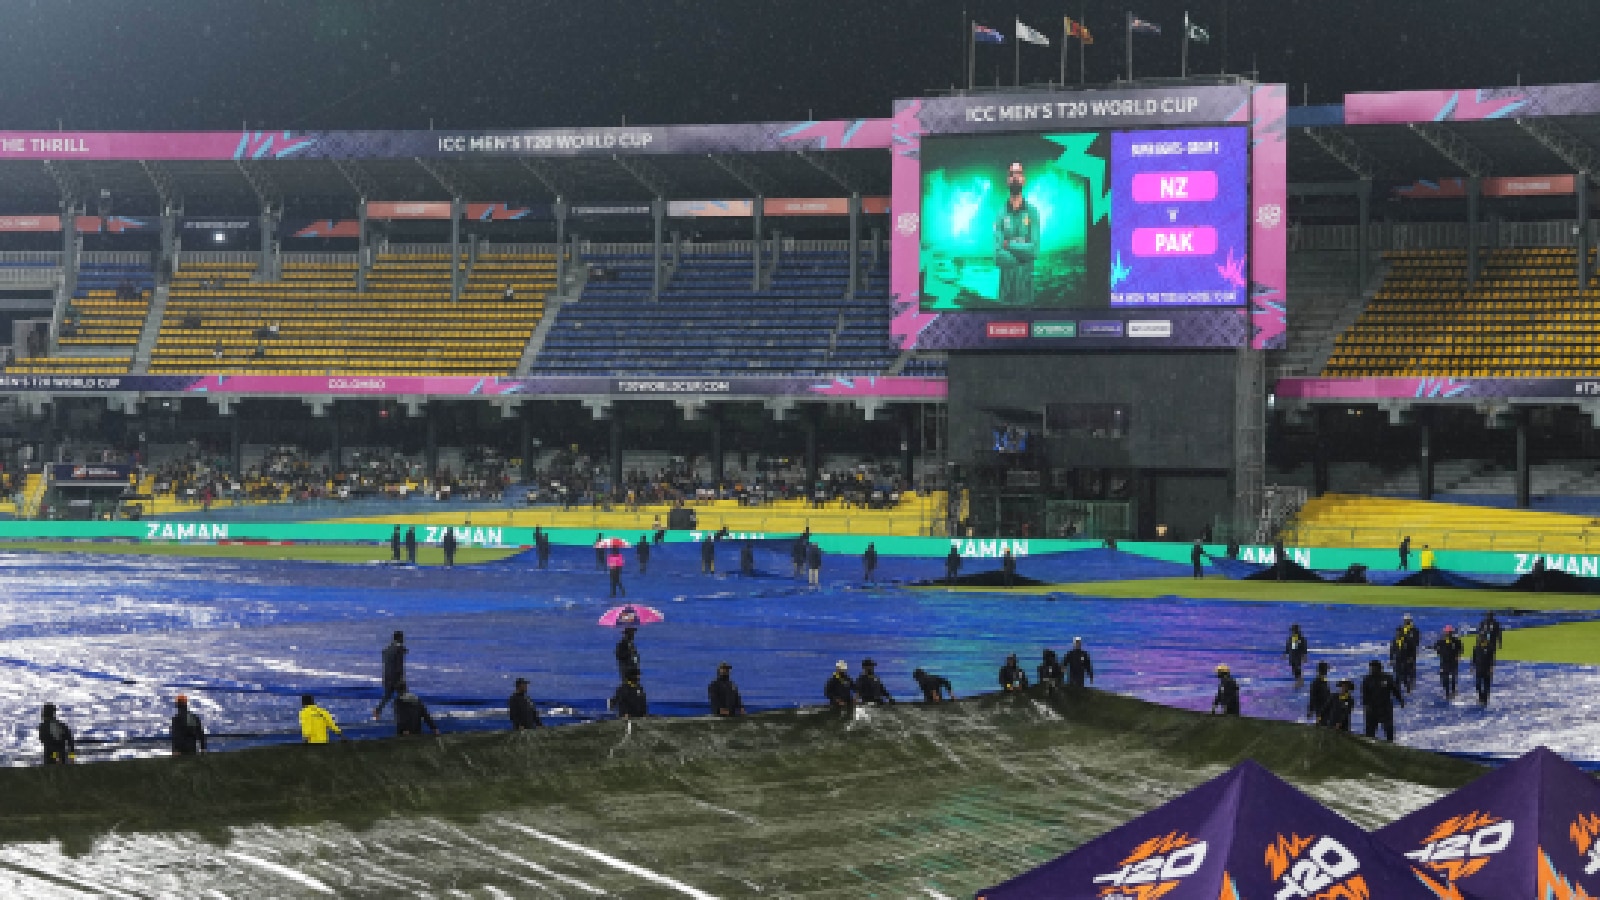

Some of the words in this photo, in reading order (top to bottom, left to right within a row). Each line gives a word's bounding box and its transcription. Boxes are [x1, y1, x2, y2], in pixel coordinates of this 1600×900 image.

[965, 105, 997, 121] ICC
[999, 102, 1052, 120] MEN'S
[1057, 102, 1088, 119] T20
[1091, 99, 1157, 116] WORLD
[1160, 97, 1198, 113] CUP
[30, 138, 90, 152] THRILL
[438, 136, 466, 151] ICC
[470, 135, 520, 151] MEN'S
[523, 135, 552, 149] T20
[556, 133, 616, 149] WORLD
[618, 132, 654, 147] CUP
[1160, 177, 1189, 198] NZ
[1155, 232, 1195, 252] PAK
[97, 378, 120, 388] CUP
[145, 521, 229, 540] ZAMAN
